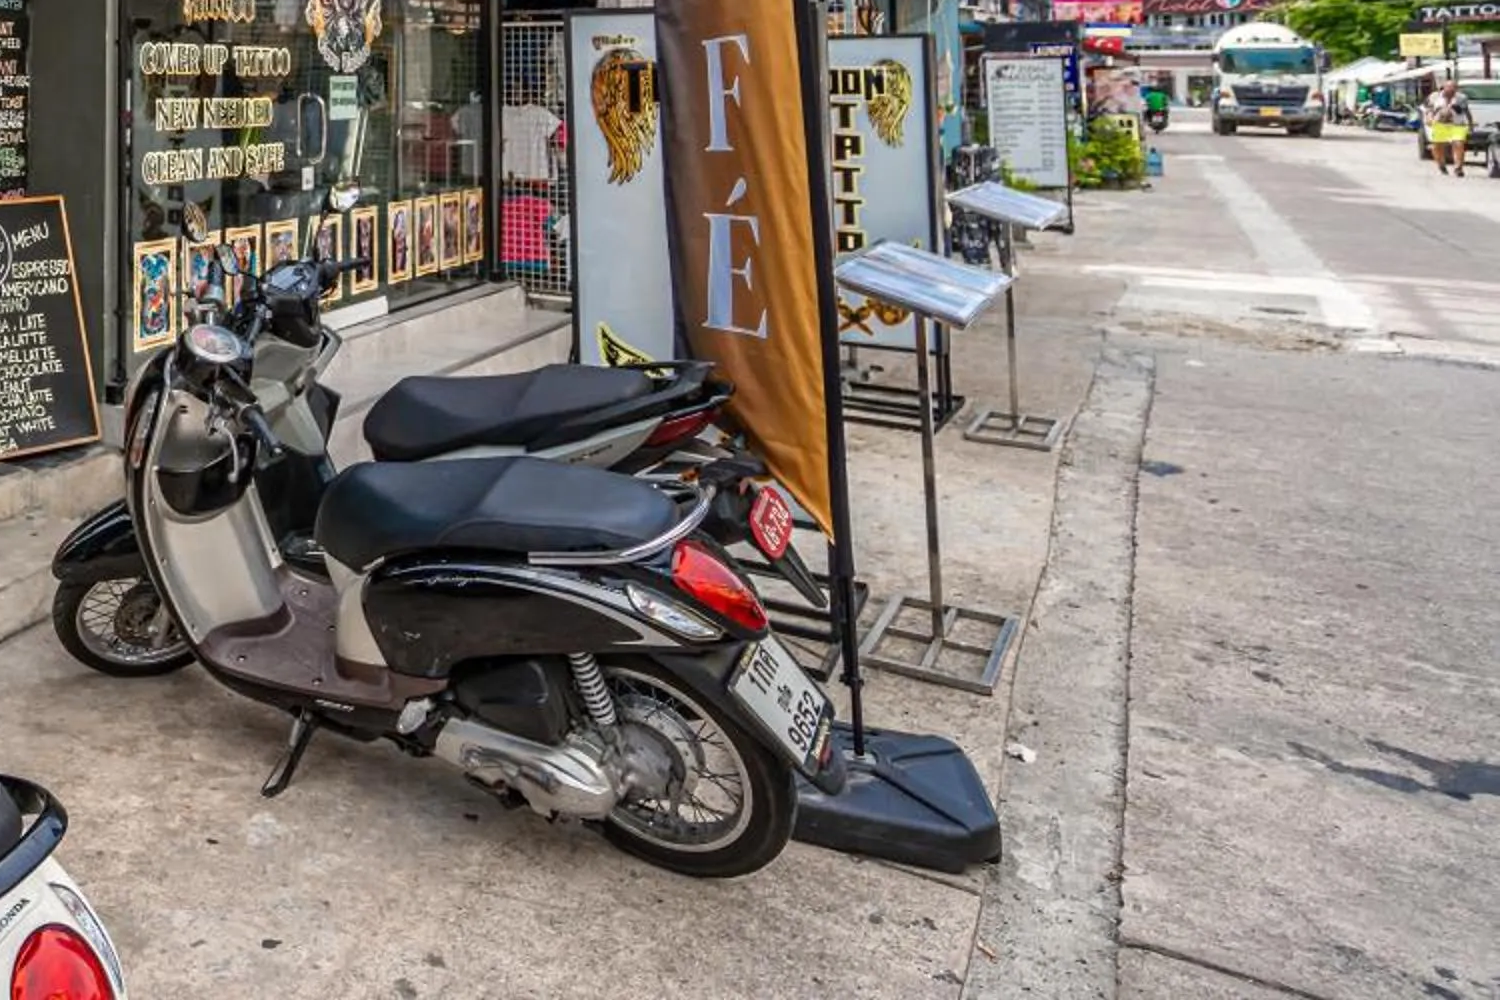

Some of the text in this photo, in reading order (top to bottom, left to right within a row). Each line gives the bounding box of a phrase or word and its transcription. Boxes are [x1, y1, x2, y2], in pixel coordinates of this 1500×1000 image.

[1421, 3, 1500, 18] TATTO
[139, 41, 292, 77] COVER UP TATTOO
[155, 97, 201, 132] NEW
[141, 141, 286, 185] CLEAN AND SAFE
[830, 101, 866, 254] TATTO
[11, 221, 49, 251] MENU
[1, 277, 69, 297] AMERICANO
[12, 331, 48, 347] LATTE
[23, 345, 57, 362] LATTE
[15, 415, 57, 434] WHITE
[787, 689, 821, 750] 9652
